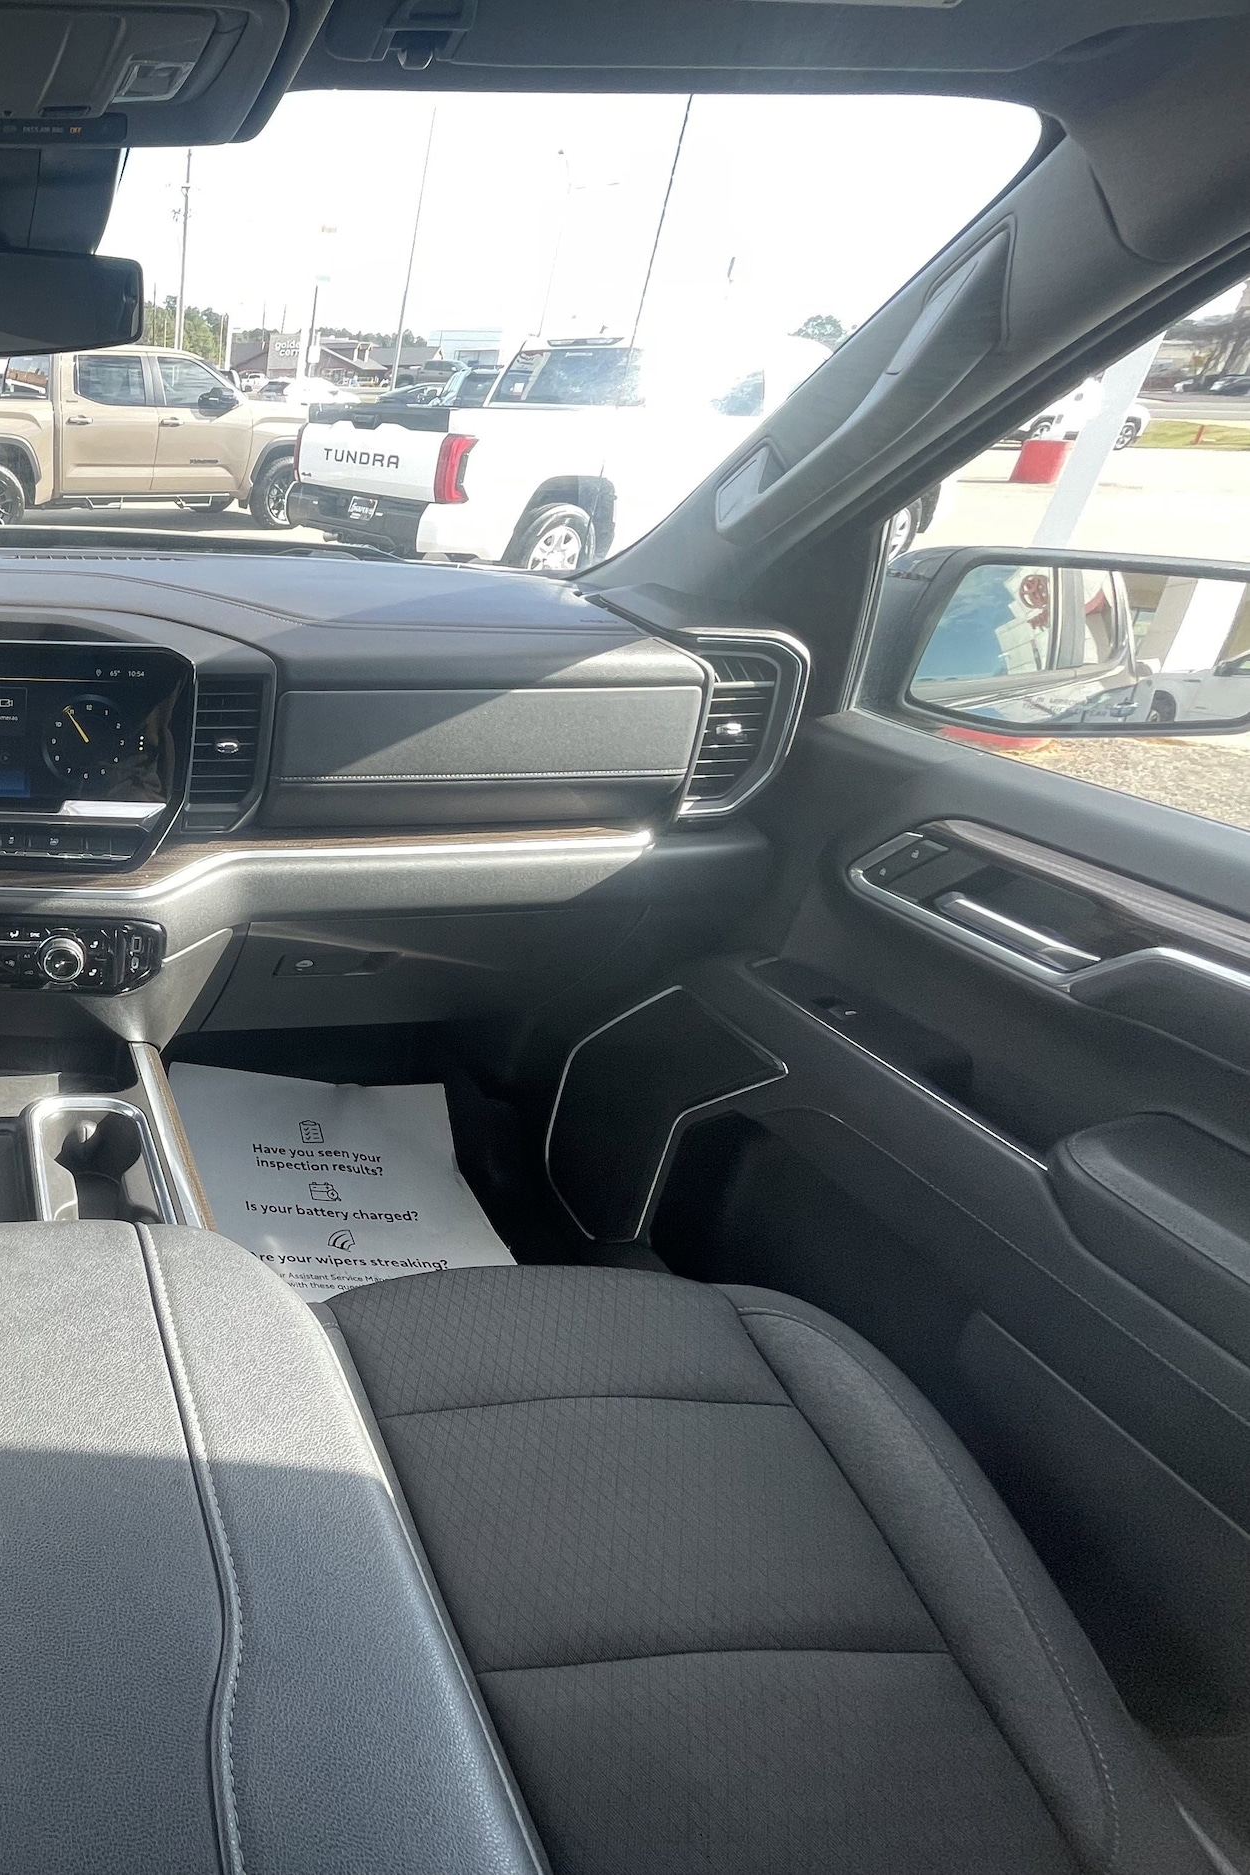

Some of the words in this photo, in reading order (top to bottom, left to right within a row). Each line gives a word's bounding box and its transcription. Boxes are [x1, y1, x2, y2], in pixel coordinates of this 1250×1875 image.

[275, 340, 300, 350] golde
[324, 448, 400, 468] TUNDRA
[252, 1144, 286, 1155] Have
[290, 1148, 314, 1158] you
[318, 1149, 350, 1158] seen
[352, 1152, 381, 1162] your
[256, 1156, 329, 1171] inspection
[332, 1163, 383, 1176] results?
[246, 1201, 257, 1211] Is
[261, 1204, 292, 1214] your
[296, 1204, 348, 1220] battery
[353, 1210, 418, 1222] charged?
[278, 1255, 312, 1264] your
[315, 1255, 366, 1267] wipers
[370, 1258, 448, 1271] streaking?
